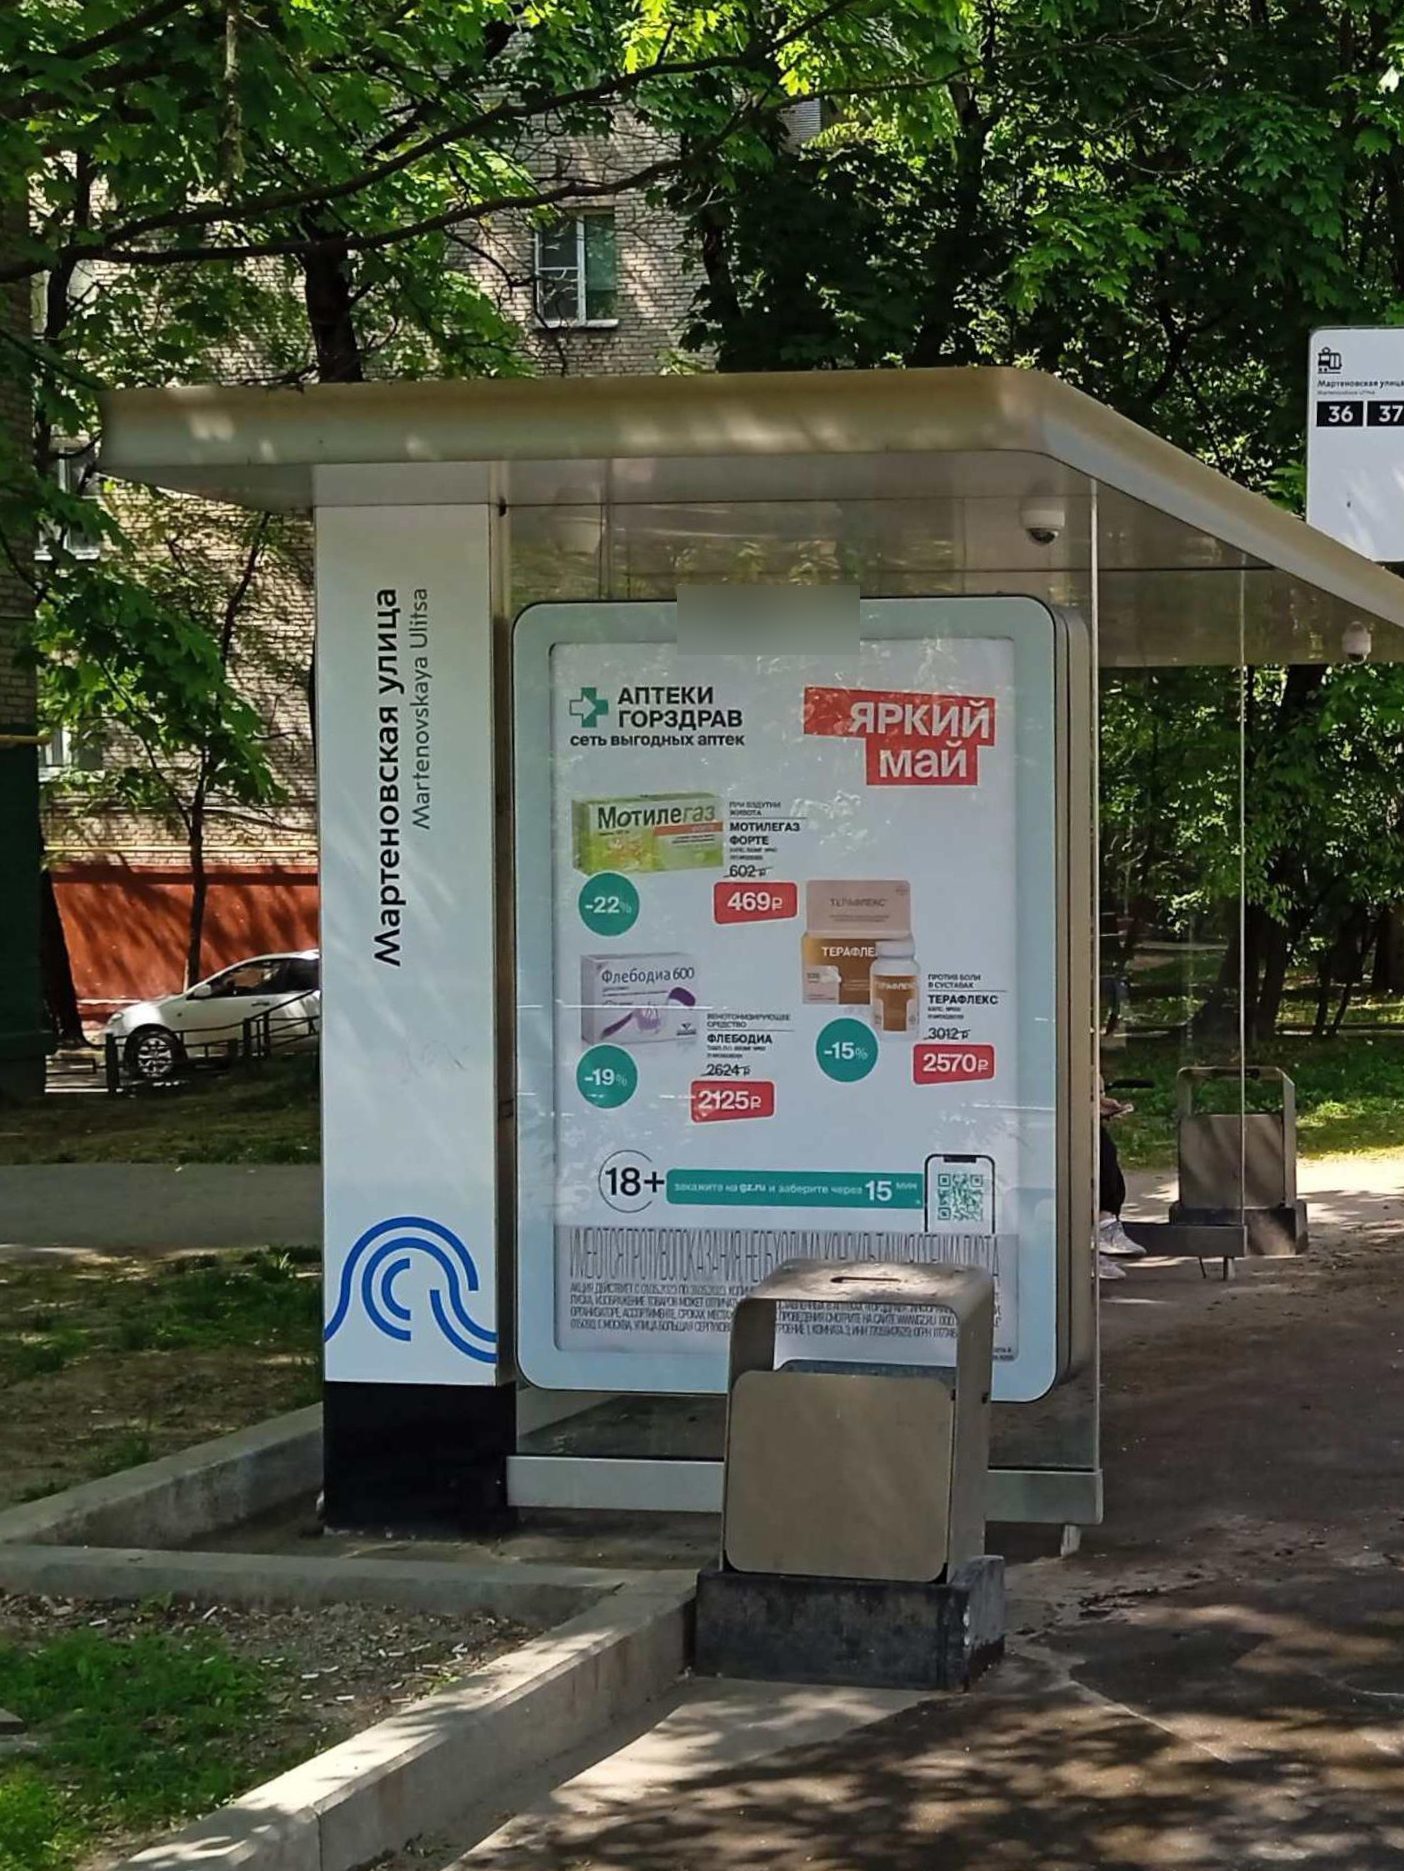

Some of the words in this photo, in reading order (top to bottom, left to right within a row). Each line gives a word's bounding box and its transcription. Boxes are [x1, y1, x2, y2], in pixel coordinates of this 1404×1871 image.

[1328, 405, 1354, 423] 36
[1379, 405, 1404, 423] 37
[408, 588, 429, 649] Ulitsa
[377, 588, 405, 695] улица
[617, 686, 714, 705] АПТЕКИ
[618, 710, 743, 731] ГОРЗДРАВ
[849, 700, 990, 739] ЯРКИЙ
[409, 656, 432, 830] Martenovskaya
[570, 735, 607, 747] сеть
[610, 735, 695, 748] выгодных
[697, 735, 745, 747] аптек
[879, 740, 967, 778] май
[597, 805, 716, 830] Мотилегаз
[729, 822, 801, 832] МОТИЛЕГАЗ
[373, 707, 407, 967] Мартеновская
[729, 836, 770, 846] ФОРТЕ
[822, 946, 876, 957] ТЕРАФЛЕ
[601, 967, 671, 984] Флебодиа
[672, 967, 696, 981] 600
[928, 994, 998, 1005] ТЕРАФЛЕКС
[706, 1034, 773, 1044] ФЛЕБОДИА
[605, 1167, 665, 1197] 18+
[739, 1183, 766, 1194] gz.ru
[865, 1180, 892, 1201] 15
